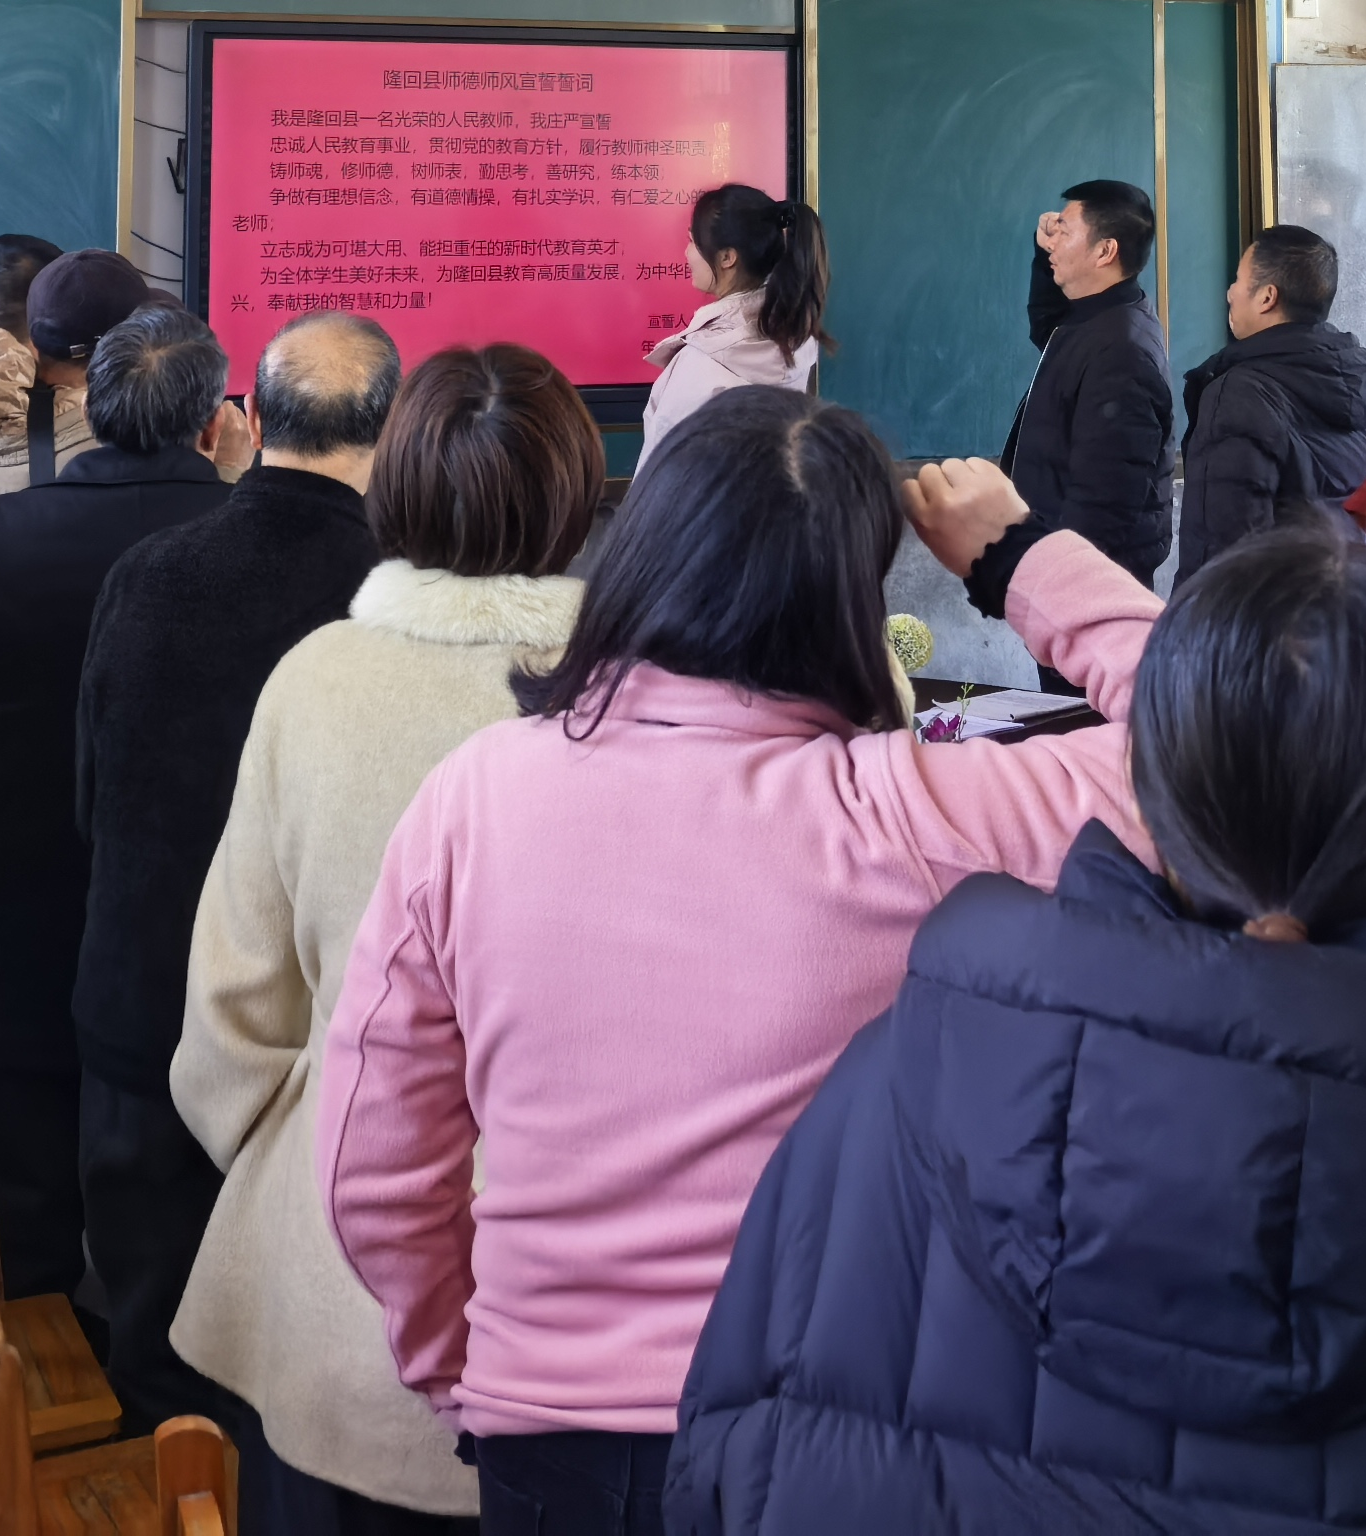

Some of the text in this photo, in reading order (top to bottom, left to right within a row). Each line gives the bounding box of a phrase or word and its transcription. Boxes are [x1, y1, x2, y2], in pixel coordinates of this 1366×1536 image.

[382, 68, 594, 94] 隆回县师德师风宣誓誓词
